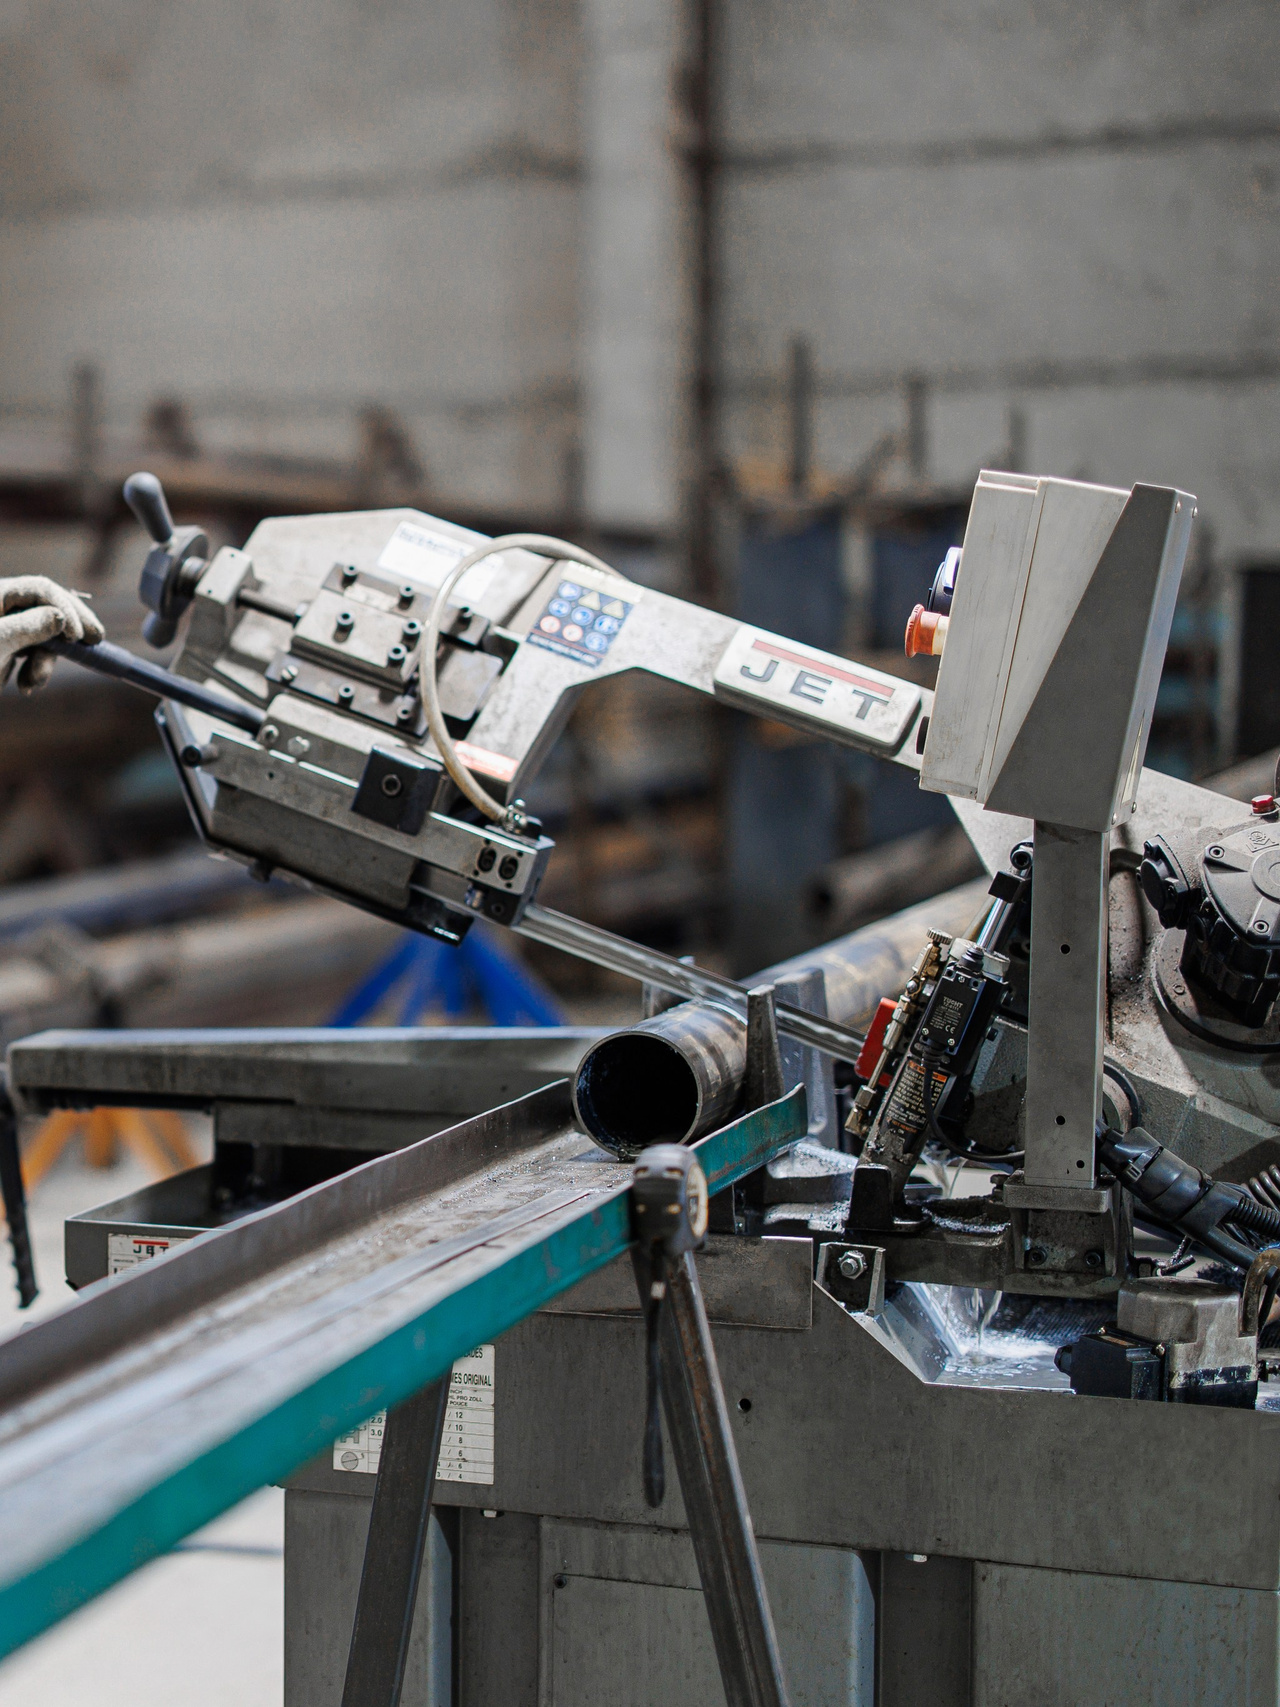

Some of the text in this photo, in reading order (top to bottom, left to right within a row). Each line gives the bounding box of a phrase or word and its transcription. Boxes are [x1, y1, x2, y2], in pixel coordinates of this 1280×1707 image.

[740, 659, 889, 721] JET
[463, 1373, 492, 1387] ORIGINAL
[370, 1416, 383, 1424] 2.0
[455, 1411, 463, 1419] 12
